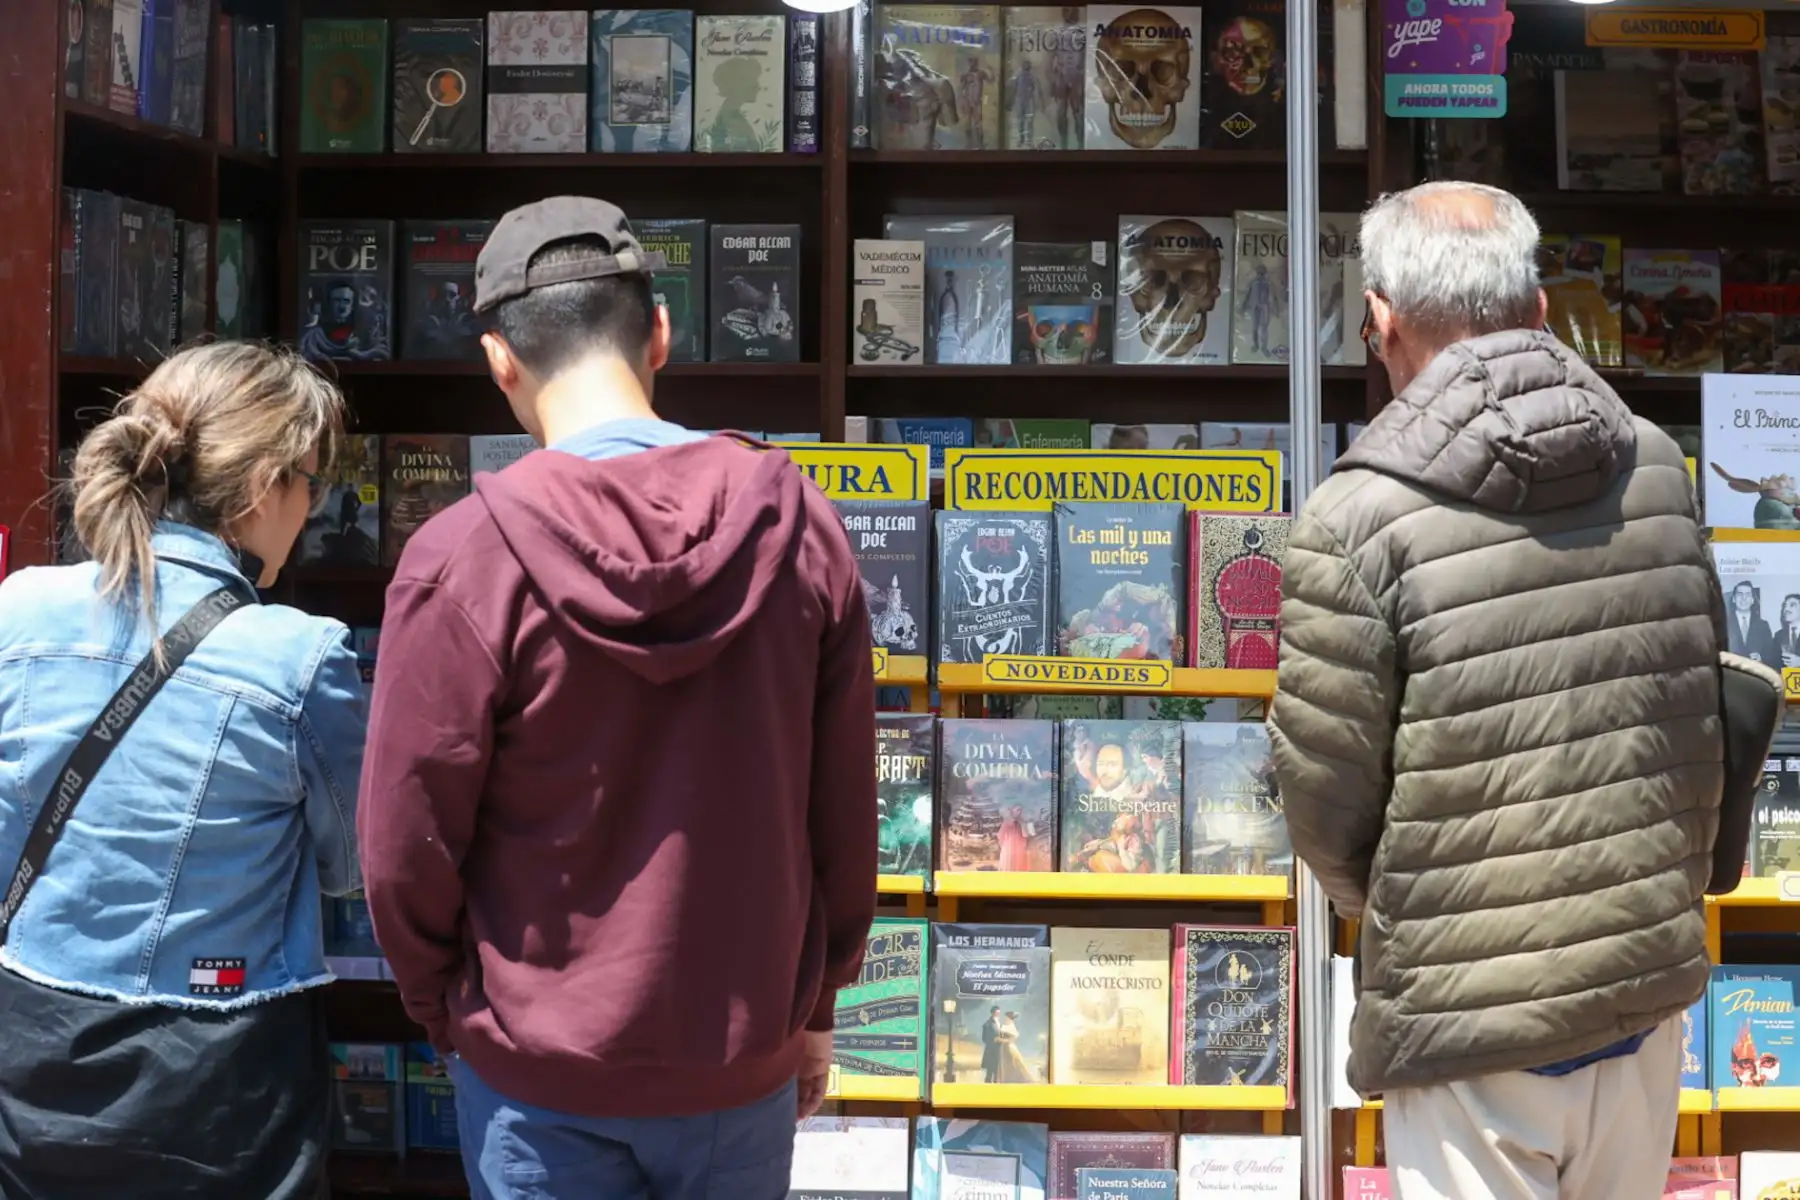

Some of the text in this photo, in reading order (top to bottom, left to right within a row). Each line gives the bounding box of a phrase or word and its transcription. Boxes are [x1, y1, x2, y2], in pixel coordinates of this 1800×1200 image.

[1620, 17, 1728, 36] GASTRONOMÍA
[1387, 18, 1443, 58] yape
[1405, 83, 1494, 95] AHORA TODOS
[1398, 97, 1499, 108] PUEDEN YAPEAR
[722, 237, 791, 249] EDGAR ALLAN
[308, 244, 378, 271] POE
[748, 249, 769, 263] POE
[859, 250, 922, 262] VADEMÉCUM
[870, 263, 910, 275] MÉDICO
[1027, 272, 1089, 284] ANATOMÍA
[1028, 284, 1080, 294] HUMANA
[1091, 282, 1103, 300] 8
[1733, 408, 1800, 429] El Princ
[904, 426, 964, 445] Enfermería
[1022, 432, 1083, 448] Enfermería
[401, 453, 452, 467] DIVINA
[392, 467, 462, 482] COMEDIA
[798, 464, 894, 493] URA
[965, 471, 1261, 503] RECOMENDACIONES
[843, 516, 916, 531] GAR ALLAN
[977, 527, 996, 537] EDGAR
[1068, 524, 1172, 548] Las mil y una
[860, 532, 887, 550] POE
[867, 553, 916, 561] COMPLETOS
[1090, 545, 1149, 565] noches
[170, 589, 241, 645] BUBBA
[1007, 663, 1151, 683] NOVEDADES
[964, 743, 1033, 760] DIVINA
[875, 754, 927, 783] RAFT
[952, 762, 1043, 780] COMEDIA
[1077, 793, 1177, 816] Shakespeare
[1758, 806, 1769, 824] el
[865, 933, 906, 957] CAR
[949, 935, 1036, 948] LOS HERMANOS
[196, 960, 241, 968] TOMMY
[1088, 953, 1136, 967] CONDE
[193, 985, 241, 993] JEANS
[1070, 975, 1163, 990] MONTECRISTO
[1222, 989, 1254, 1003] DON
[1721, 988, 1794, 1016] Demian
[1207, 1001, 1270, 1020] QUIJOTE
[1220, 1020, 1256, 1032] DE LA
[1206, 1031, 1268, 1047] MANCHA
[1189, 1156, 1284, 1178] Jane Austen
[1088, 1176, 1167, 1189] Nuestra Señora
[1360, 1177, 1377, 1189] La
[1088, 1190, 1129, 1200] de París
